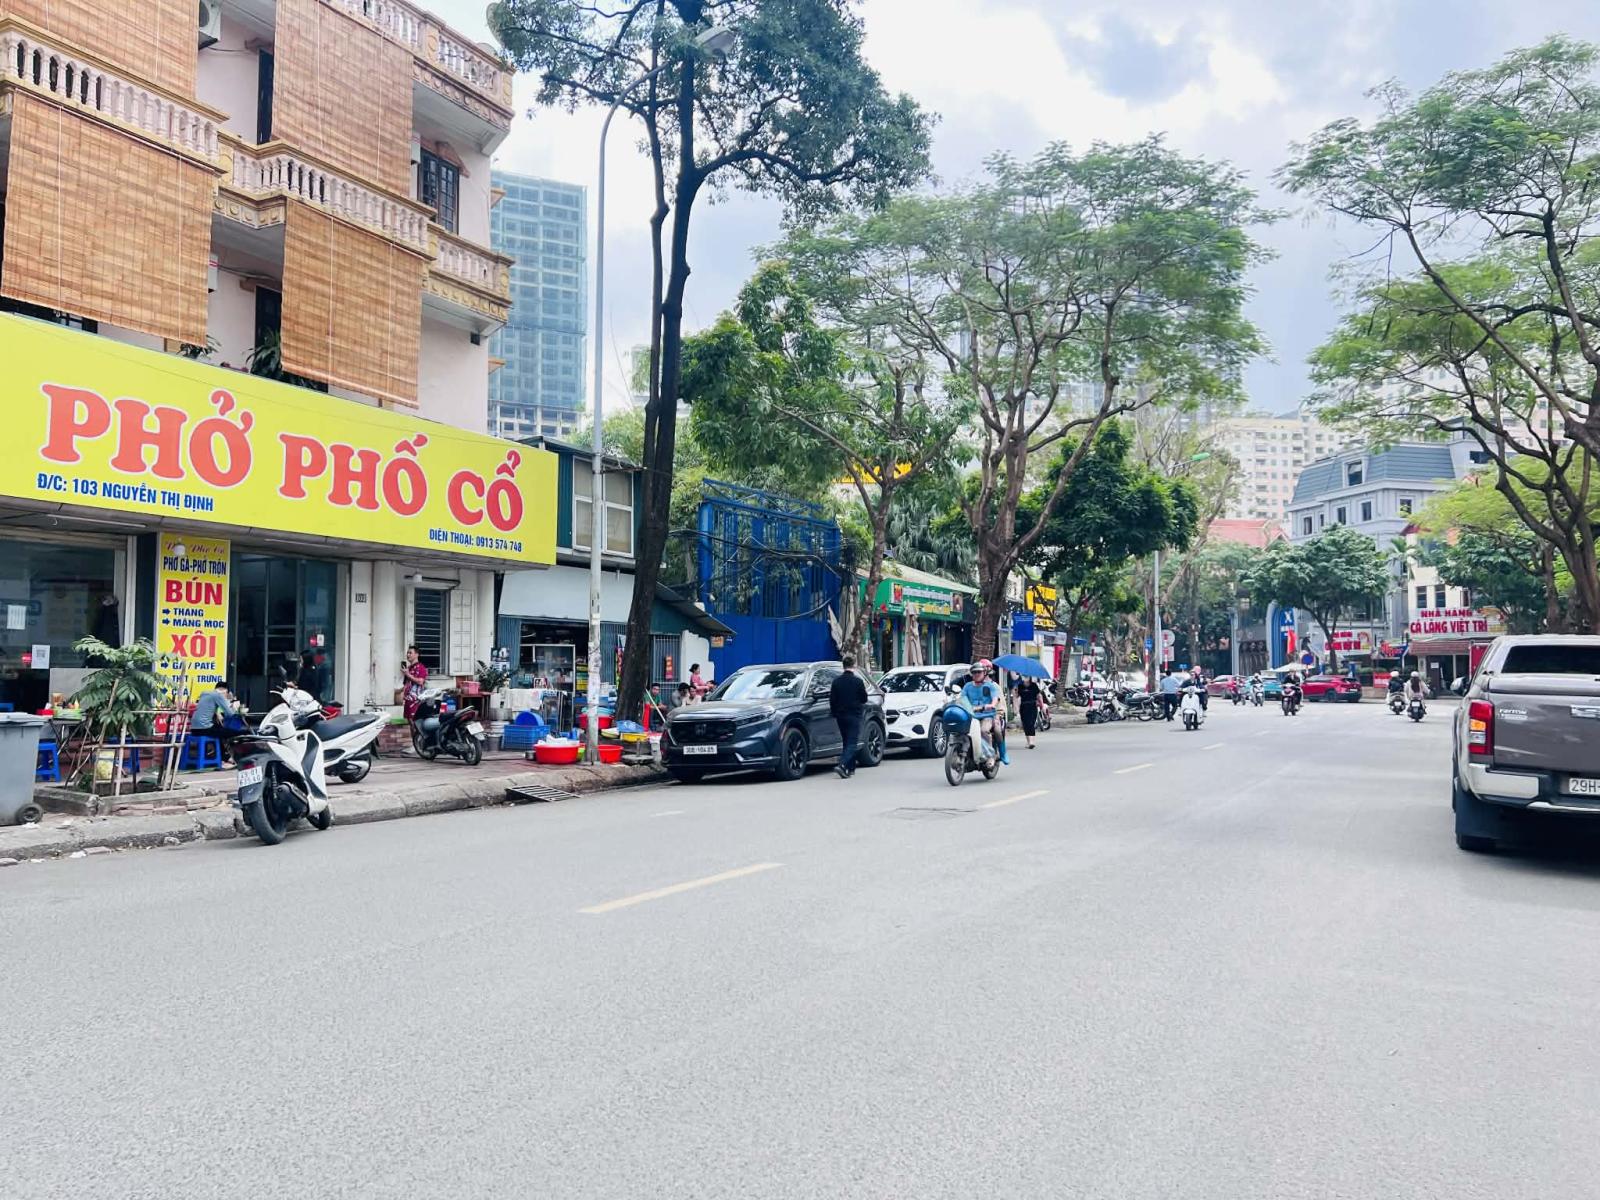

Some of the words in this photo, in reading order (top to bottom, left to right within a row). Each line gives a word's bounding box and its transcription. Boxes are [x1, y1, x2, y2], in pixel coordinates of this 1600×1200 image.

[39, 383, 254, 488] PHỞ
[278, 433, 428, 516] PHỐ
[446, 450, 523, 532] CỔ
[37, 473, 68, 491] Đ/C:
[72, 478, 98, 495] 103
[102, 482, 157, 504] NGUYỄN
[160, 490, 180, 510] THỊ
[184, 494, 214, 512] ĐỊNH
[476, 536, 493, 549] 0913
[165, 576, 223, 605] BÚN
[173, 608, 204, 617] THANG
[171, 630, 217, 658] XÔI
